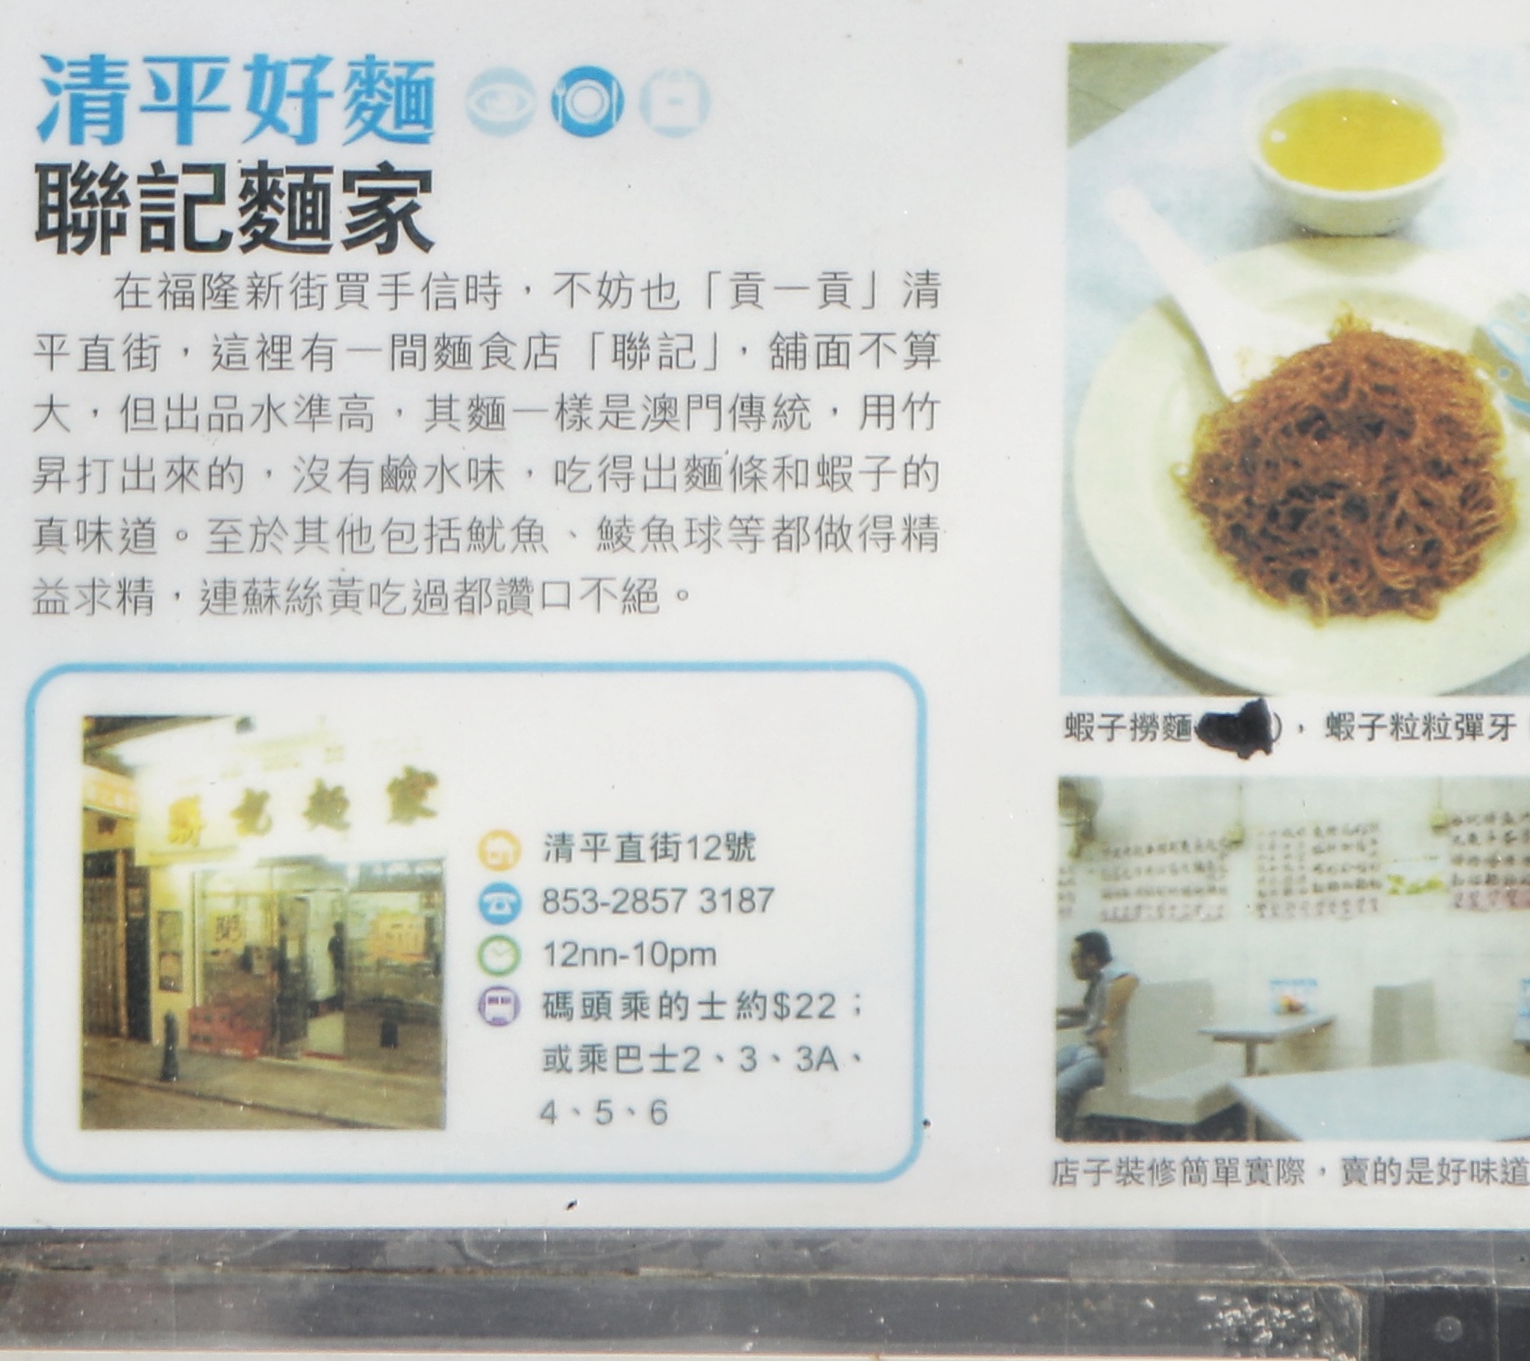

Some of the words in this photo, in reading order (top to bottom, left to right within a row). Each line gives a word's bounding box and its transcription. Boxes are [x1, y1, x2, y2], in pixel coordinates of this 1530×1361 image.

[33, 51, 436, 148] 清平好麵
[32, 158, 436, 257] 聯記麵家
[542, 829, 758, 867] 清平直街12號
[540, 886, 687, 917] 853-2857
[699, 885, 776, 916] 3187
[542, 939, 718, 974] 12nn-10pm
